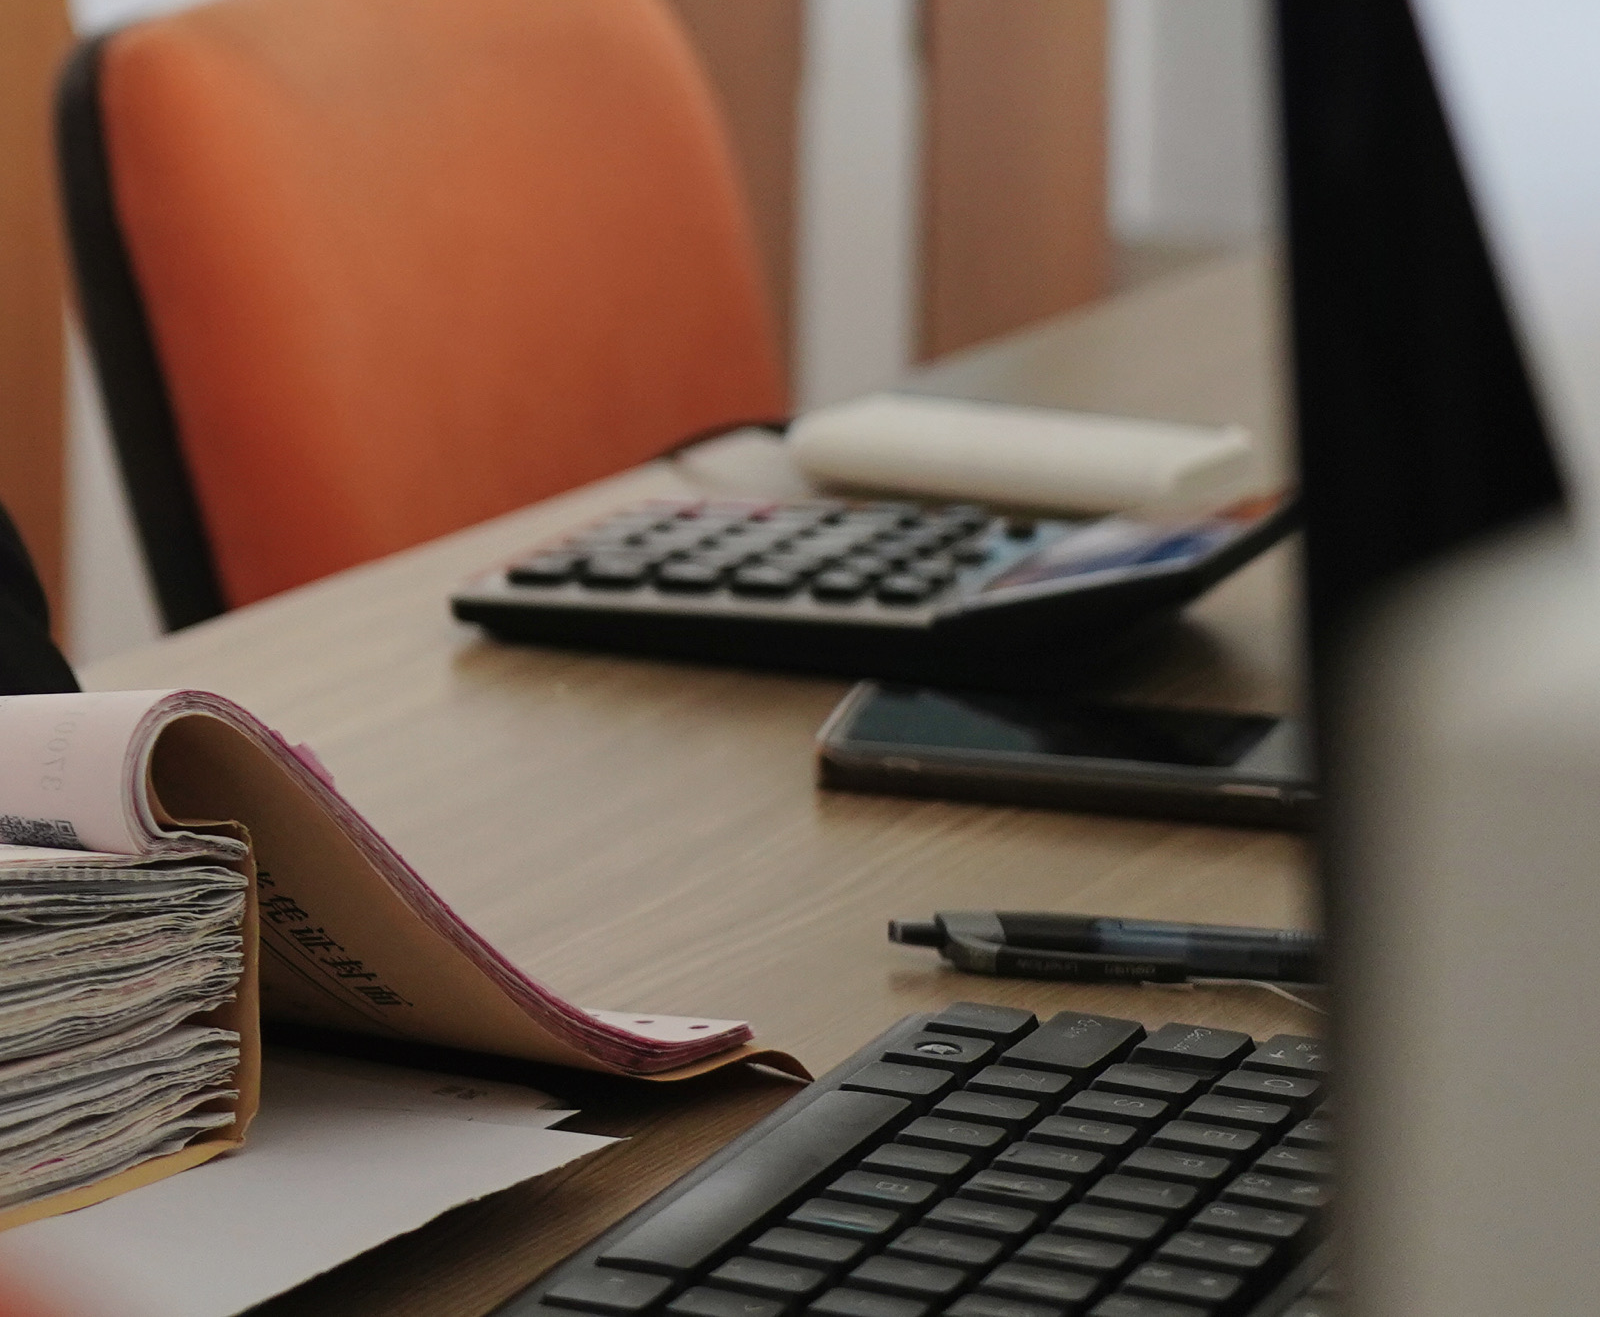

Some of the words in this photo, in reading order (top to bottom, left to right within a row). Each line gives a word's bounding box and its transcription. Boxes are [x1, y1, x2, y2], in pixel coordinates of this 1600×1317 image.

[947, 1128, 978, 1137] C
[1203, 1131, 1236, 1140] E
[877, 1182, 909, 1192] B
